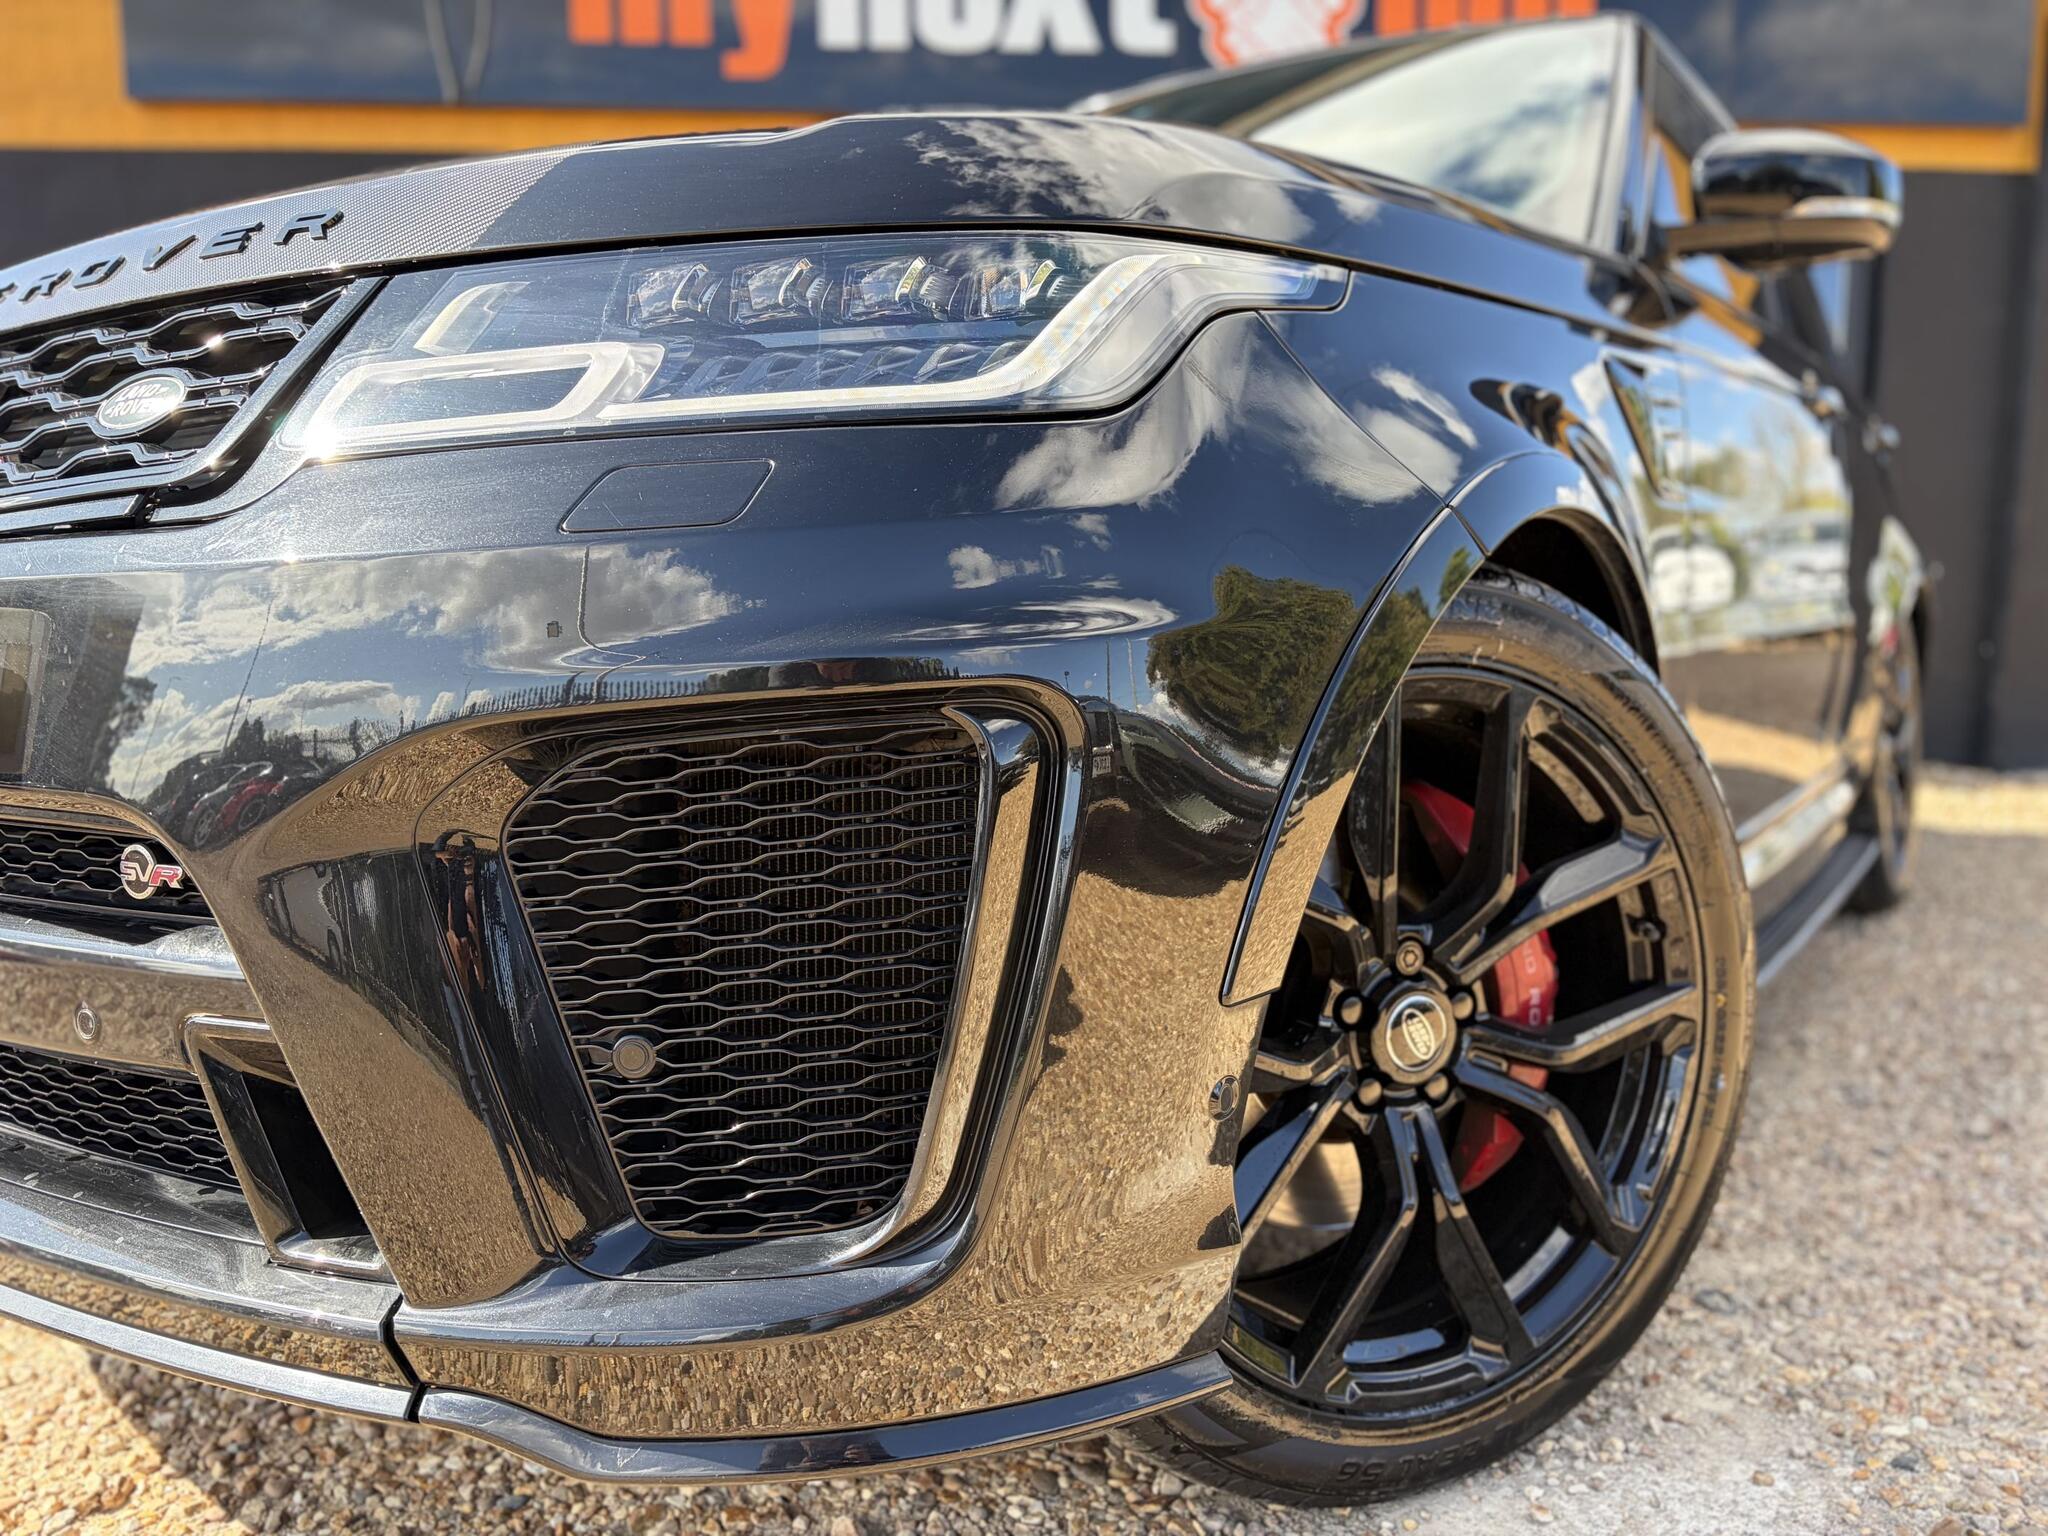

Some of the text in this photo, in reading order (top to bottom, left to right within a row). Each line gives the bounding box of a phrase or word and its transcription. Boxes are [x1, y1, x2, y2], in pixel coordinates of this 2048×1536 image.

[19, 210, 344, 302] ROVER
[115, 383, 162, 402] LAND
[120, 861, 183, 889] SVR
